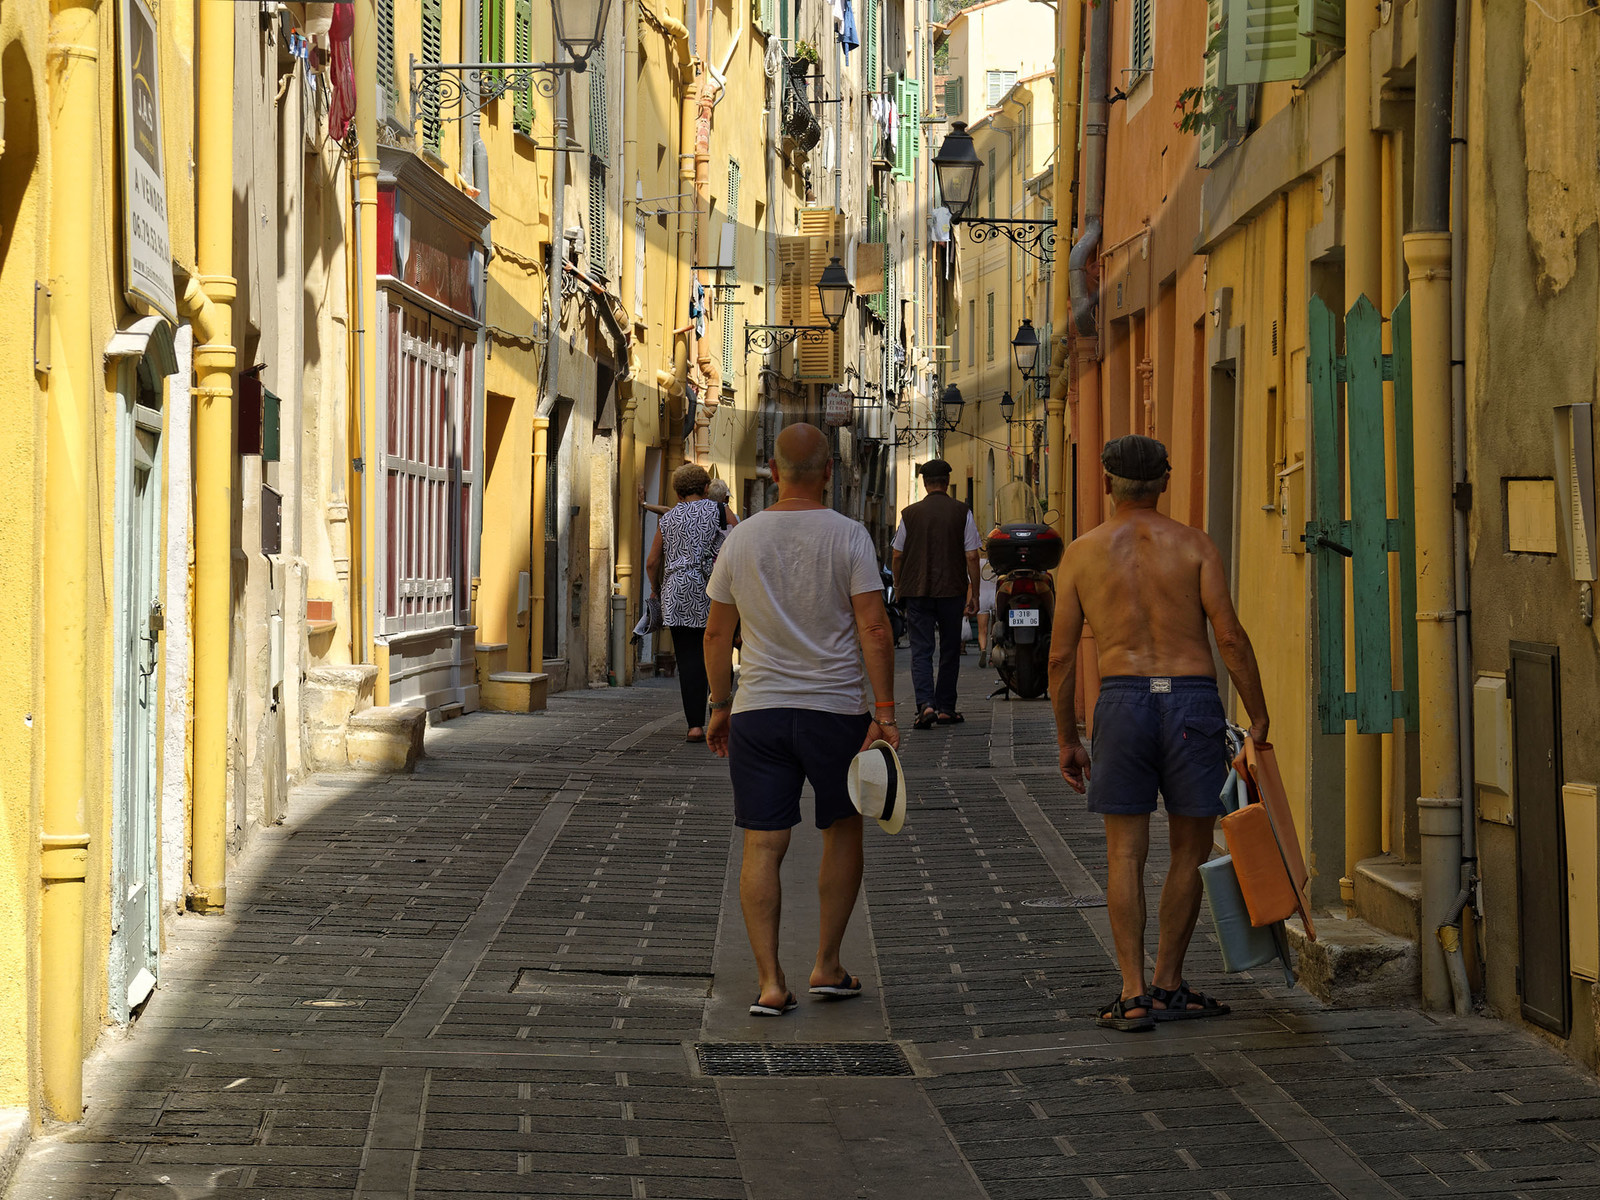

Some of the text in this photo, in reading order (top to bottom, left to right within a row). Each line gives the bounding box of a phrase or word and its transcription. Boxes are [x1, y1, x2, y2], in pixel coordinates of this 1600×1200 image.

[138, 88, 153, 131] JAS
[134, 168, 140, 194] A
[141, 173, 165, 222] VENDRE
